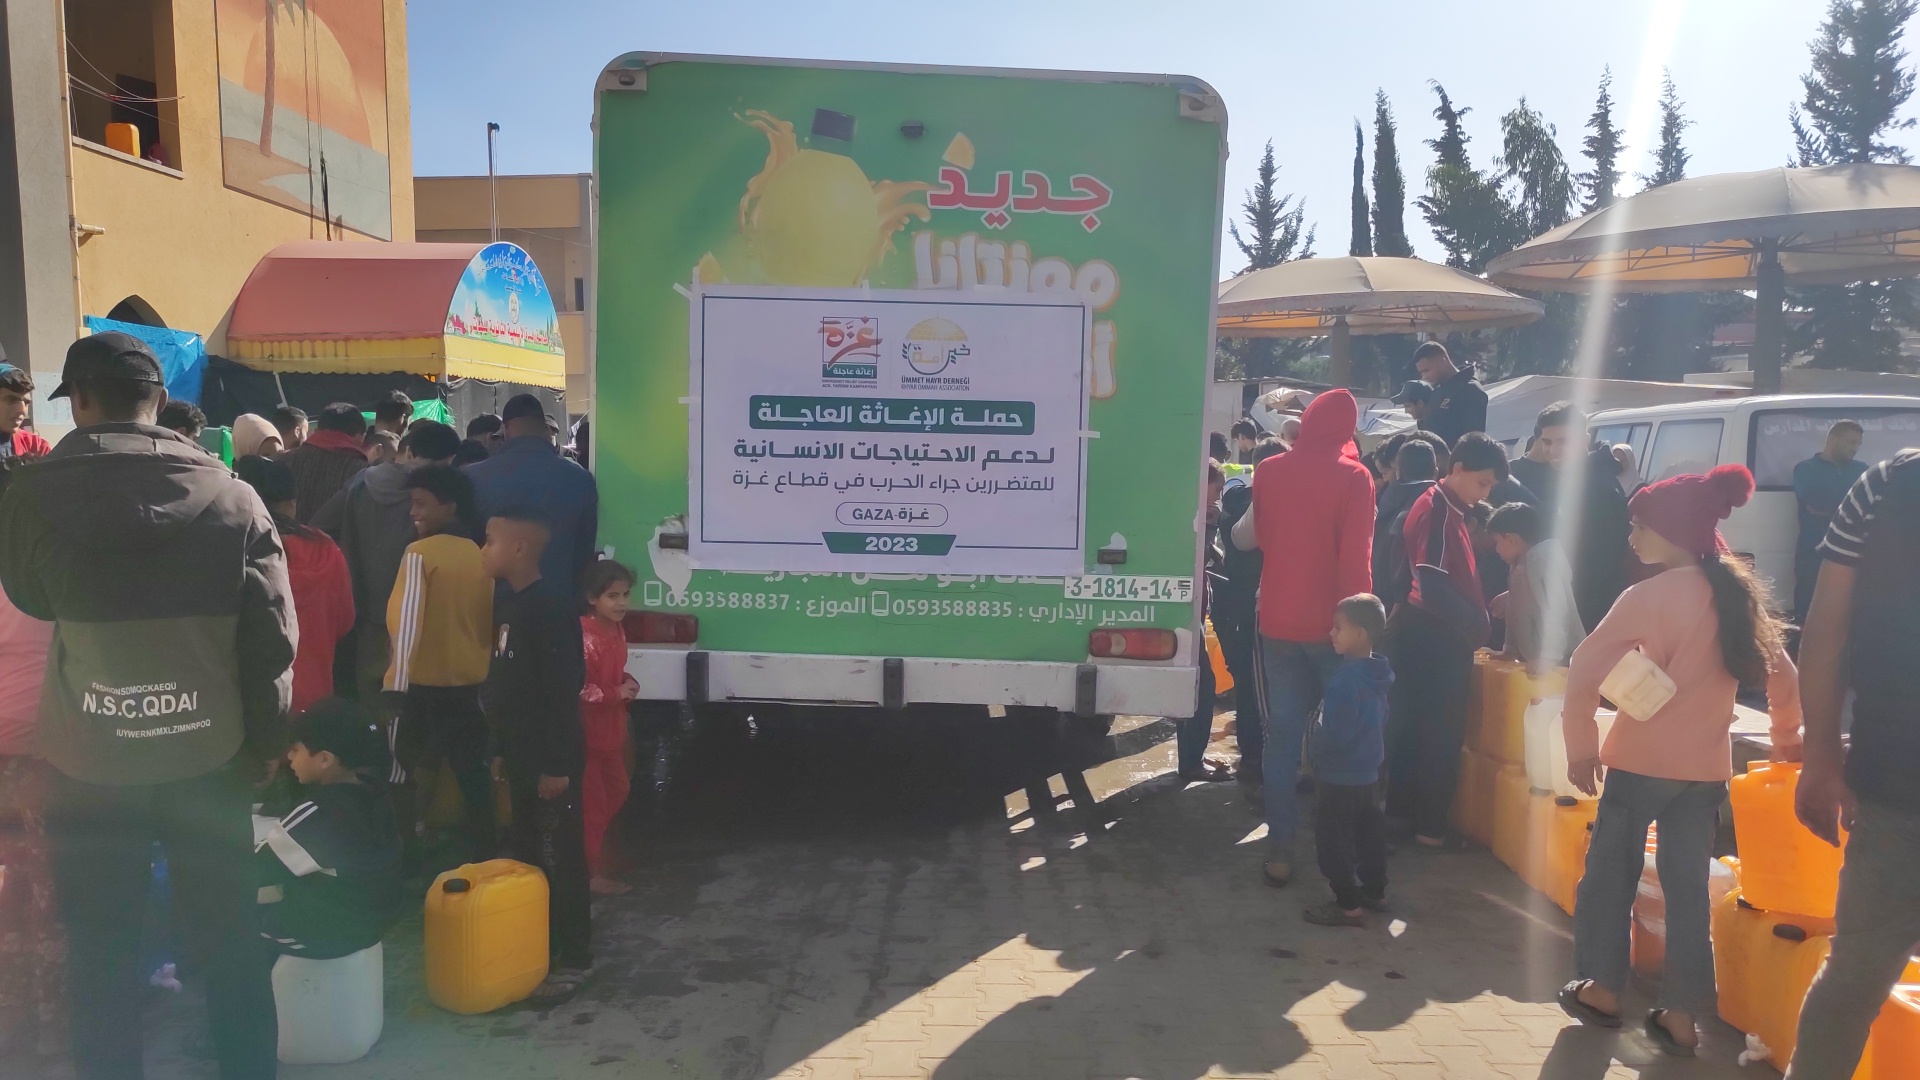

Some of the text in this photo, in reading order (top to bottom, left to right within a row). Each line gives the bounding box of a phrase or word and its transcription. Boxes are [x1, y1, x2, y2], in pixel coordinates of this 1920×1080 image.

[927, 166, 1114, 233] جديد
[832, 367, 855, 377] عاجلة
[901, 376, 925, 384] ÜMMET
[757, 401, 1023, 430] حملة الإغاثة العاجلة
[733, 438, 1055, 471] لدعم الاحتياجات الانسانية
[732, 469, 1055, 494] للمتضررين جراء الحرب في قطاع غزة
[865, 536, 919, 552] 2023
[805, 595, 866, 618] الموزع
[892, 599, 1013, 618] 0593588835
[1029, 602, 1094, 625] الإداري
[1098, 605, 1155, 627] المدير
[83, 691, 198, 719] N.S.C.QDAI
